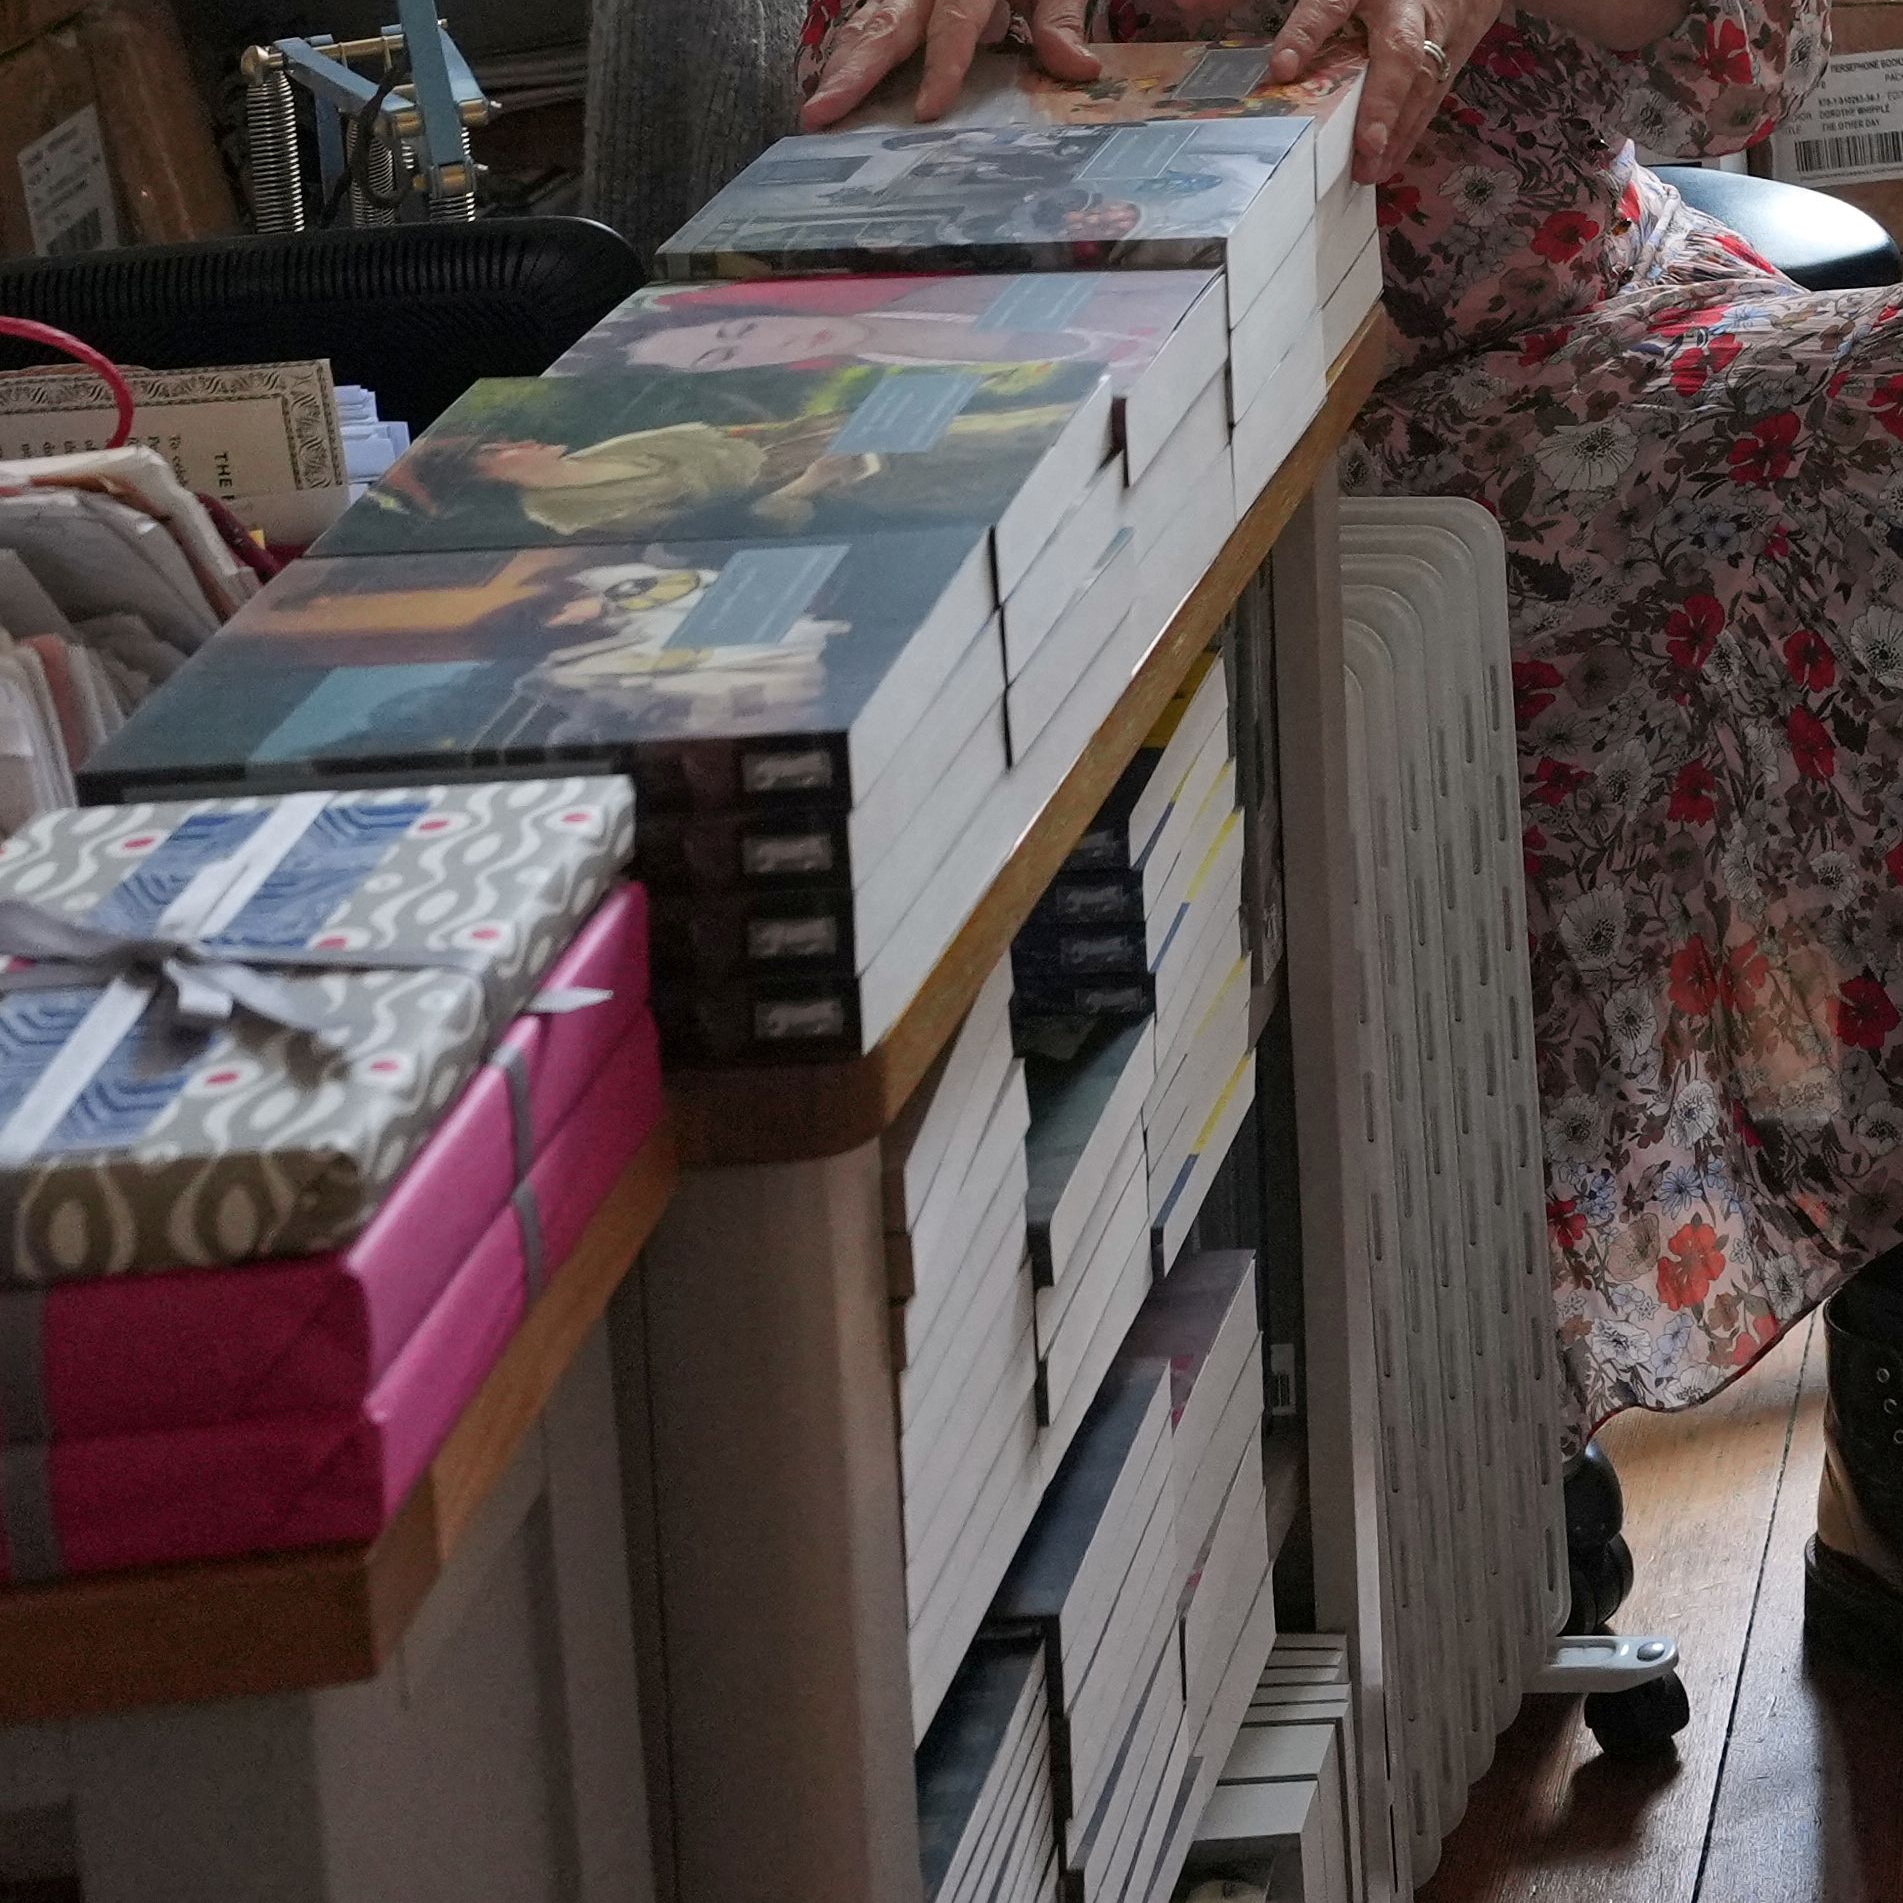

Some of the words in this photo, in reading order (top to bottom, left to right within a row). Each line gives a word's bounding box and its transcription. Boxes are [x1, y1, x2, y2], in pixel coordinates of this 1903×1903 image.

[1822, 122, 1837, 131] THE
[1837, 119, 1864, 130] OTHER
[213, 452, 233, 488] THE
